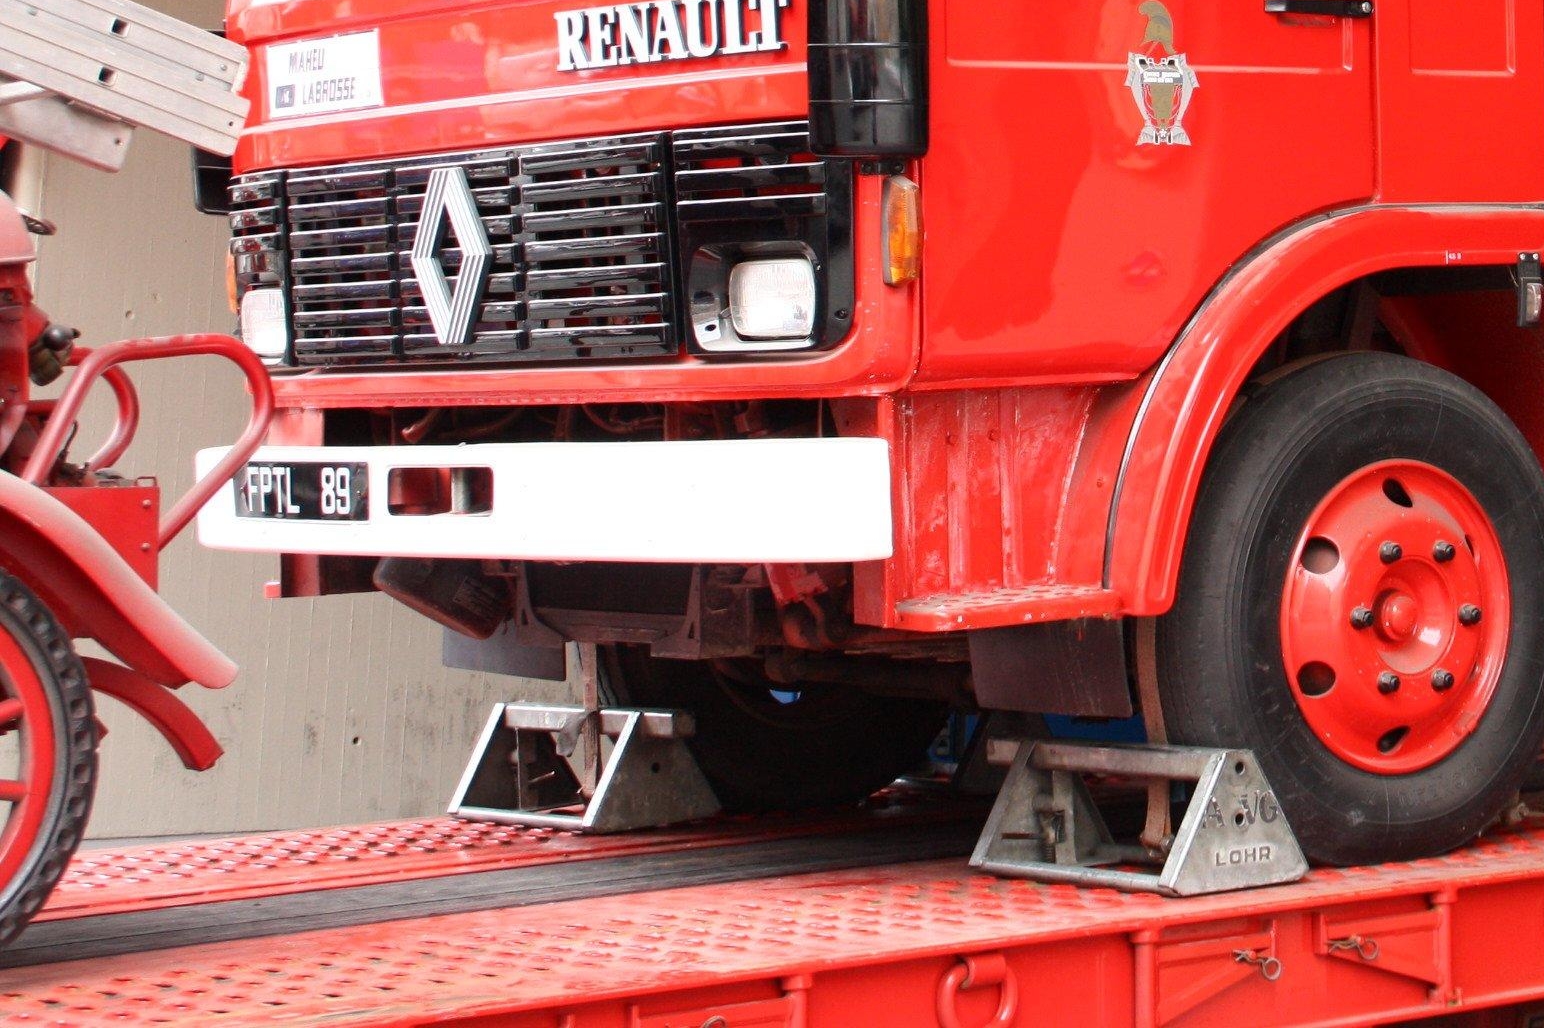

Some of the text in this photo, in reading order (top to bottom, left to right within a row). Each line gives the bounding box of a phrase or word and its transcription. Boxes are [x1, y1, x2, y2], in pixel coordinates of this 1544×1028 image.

[289, 48, 325, 74] MAHEU
[302, 77, 356, 105] LABROSSE
[247, 466, 351, 514] FPTL 89
[1215, 845, 1272, 867] LOHR
